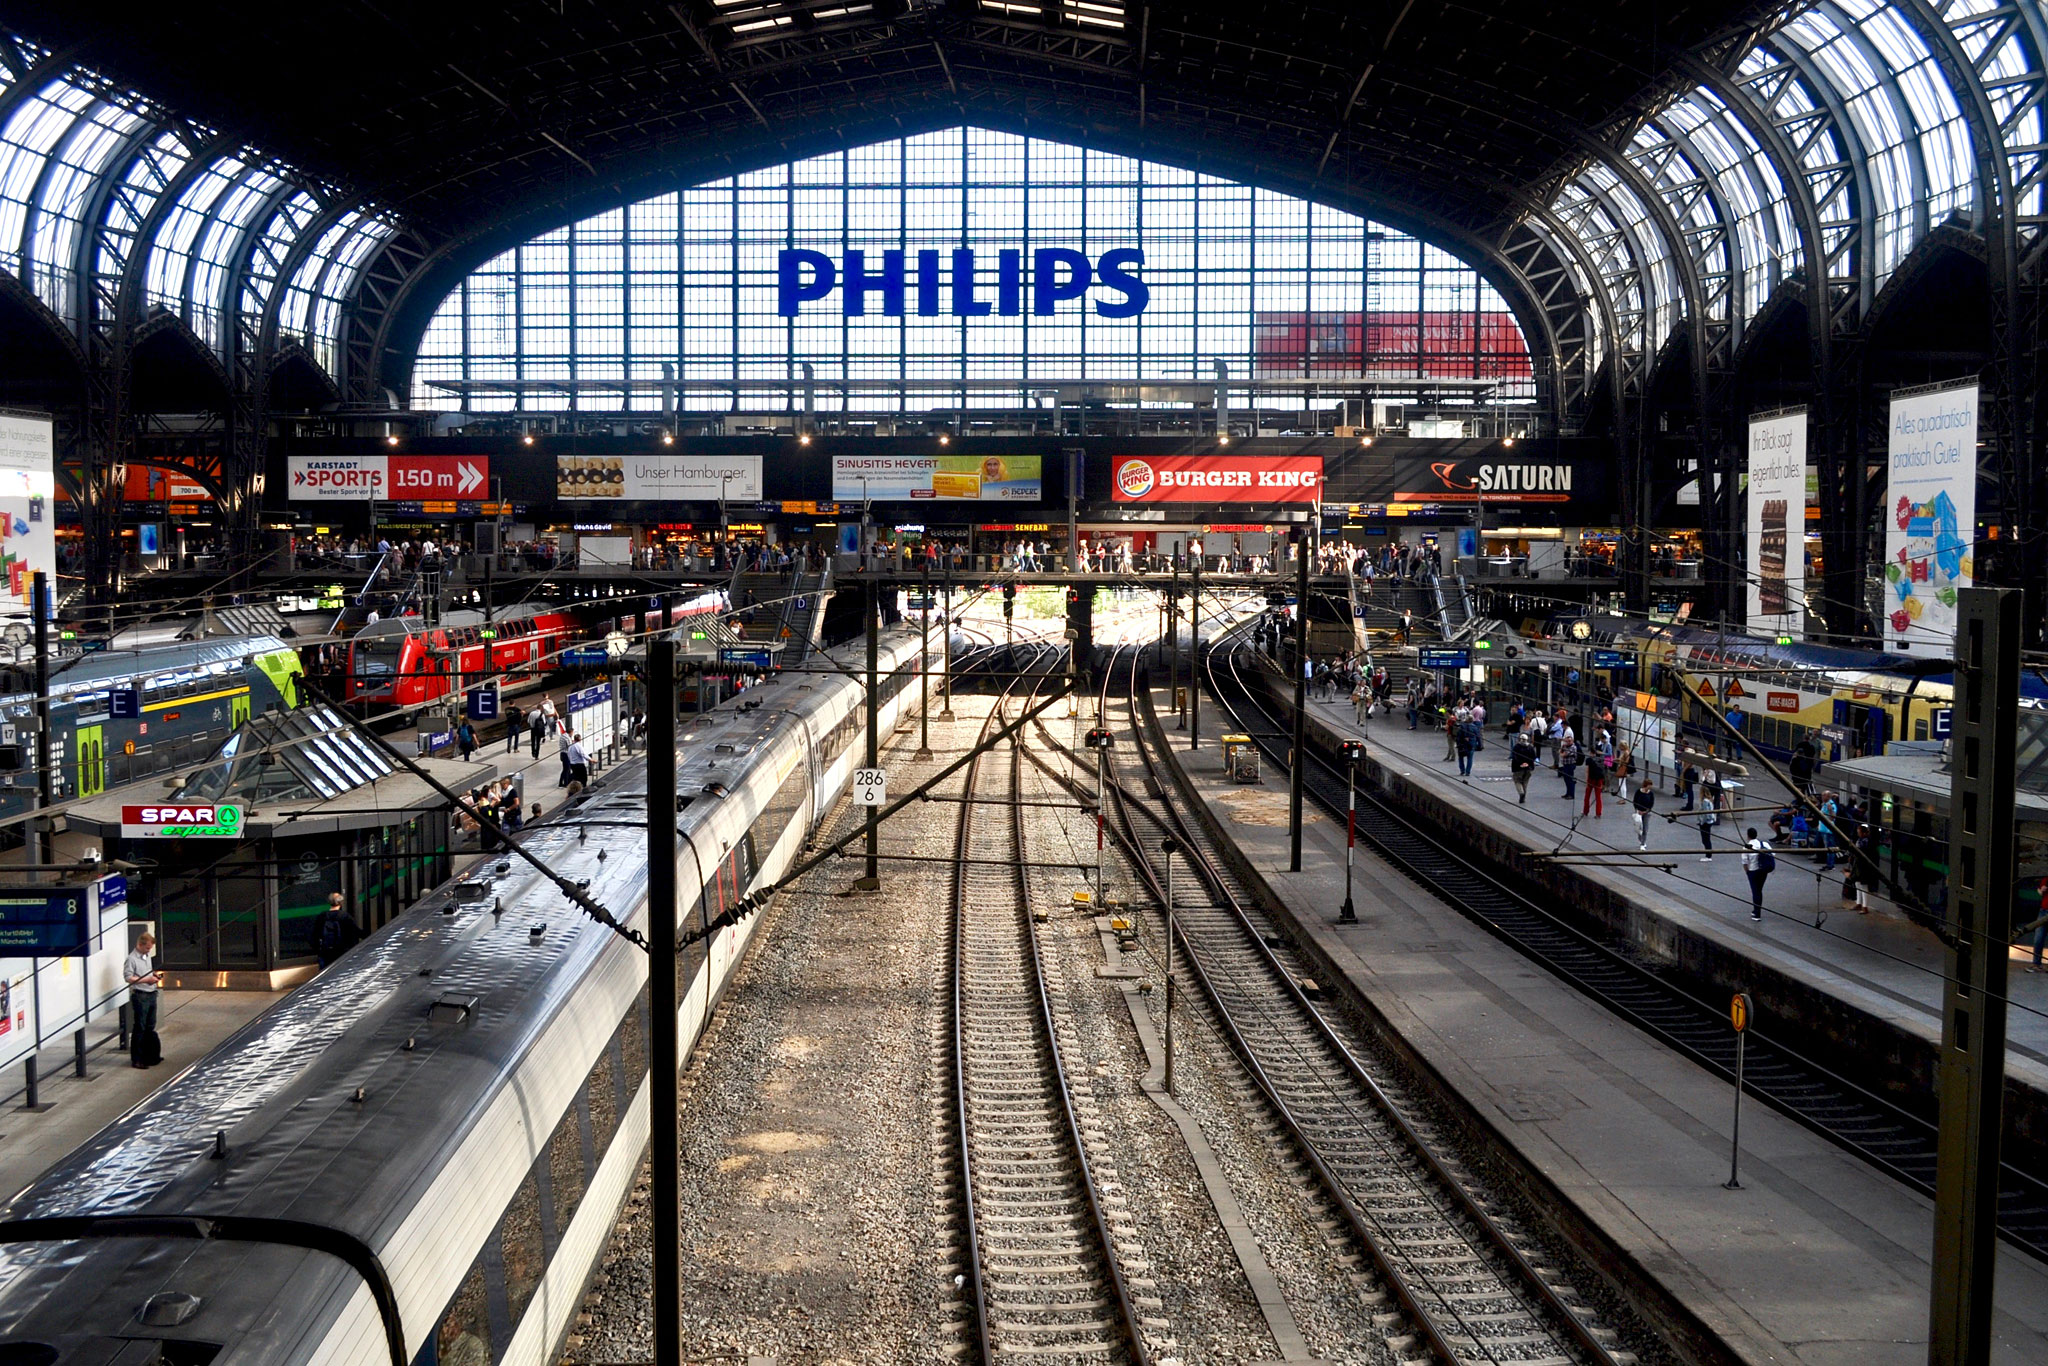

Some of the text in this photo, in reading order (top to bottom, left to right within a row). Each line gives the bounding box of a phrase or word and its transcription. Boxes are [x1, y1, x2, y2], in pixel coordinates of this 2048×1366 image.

[778, 248, 1150, 318] PHILIPS
[1894, 401, 1971, 438] Alles quadratisch
[1753, 427, 1792, 454] Ihr Blick sagt
[837, 460, 938, 469] SINUSITIS HEVERT
[1893, 440, 1961, 476] praktisch Gute!
[307, 470, 382, 486] SPORTS
[397, 470, 453, 486] 150 m
[635, 464, 747, 482] Unser Hamburger.
[1122, 467, 1149, 480] BURGER
[1160, 471, 1316, 486] BURGER KING
[1480, 465, 1572, 490] SATURN
[1752, 456, 1800, 487] eigentlich alles.
[1123, 473, 1150, 488] KING
[651, 597, 658, 606] D
[798, 598, 805, 607] D
[1355, 607, 1362, 616] D
[113, 693, 126, 714] E
[478, 693, 492, 714] E
[1936, 710, 1950, 732] E
[5, 730, 14, 739] t7
[856, 770, 883, 785] 286
[865, 787, 874, 801] 6
[142, 808, 213, 822] SPAR
[161, 826, 239, 837] express
[67, 899, 76, 914] 8
